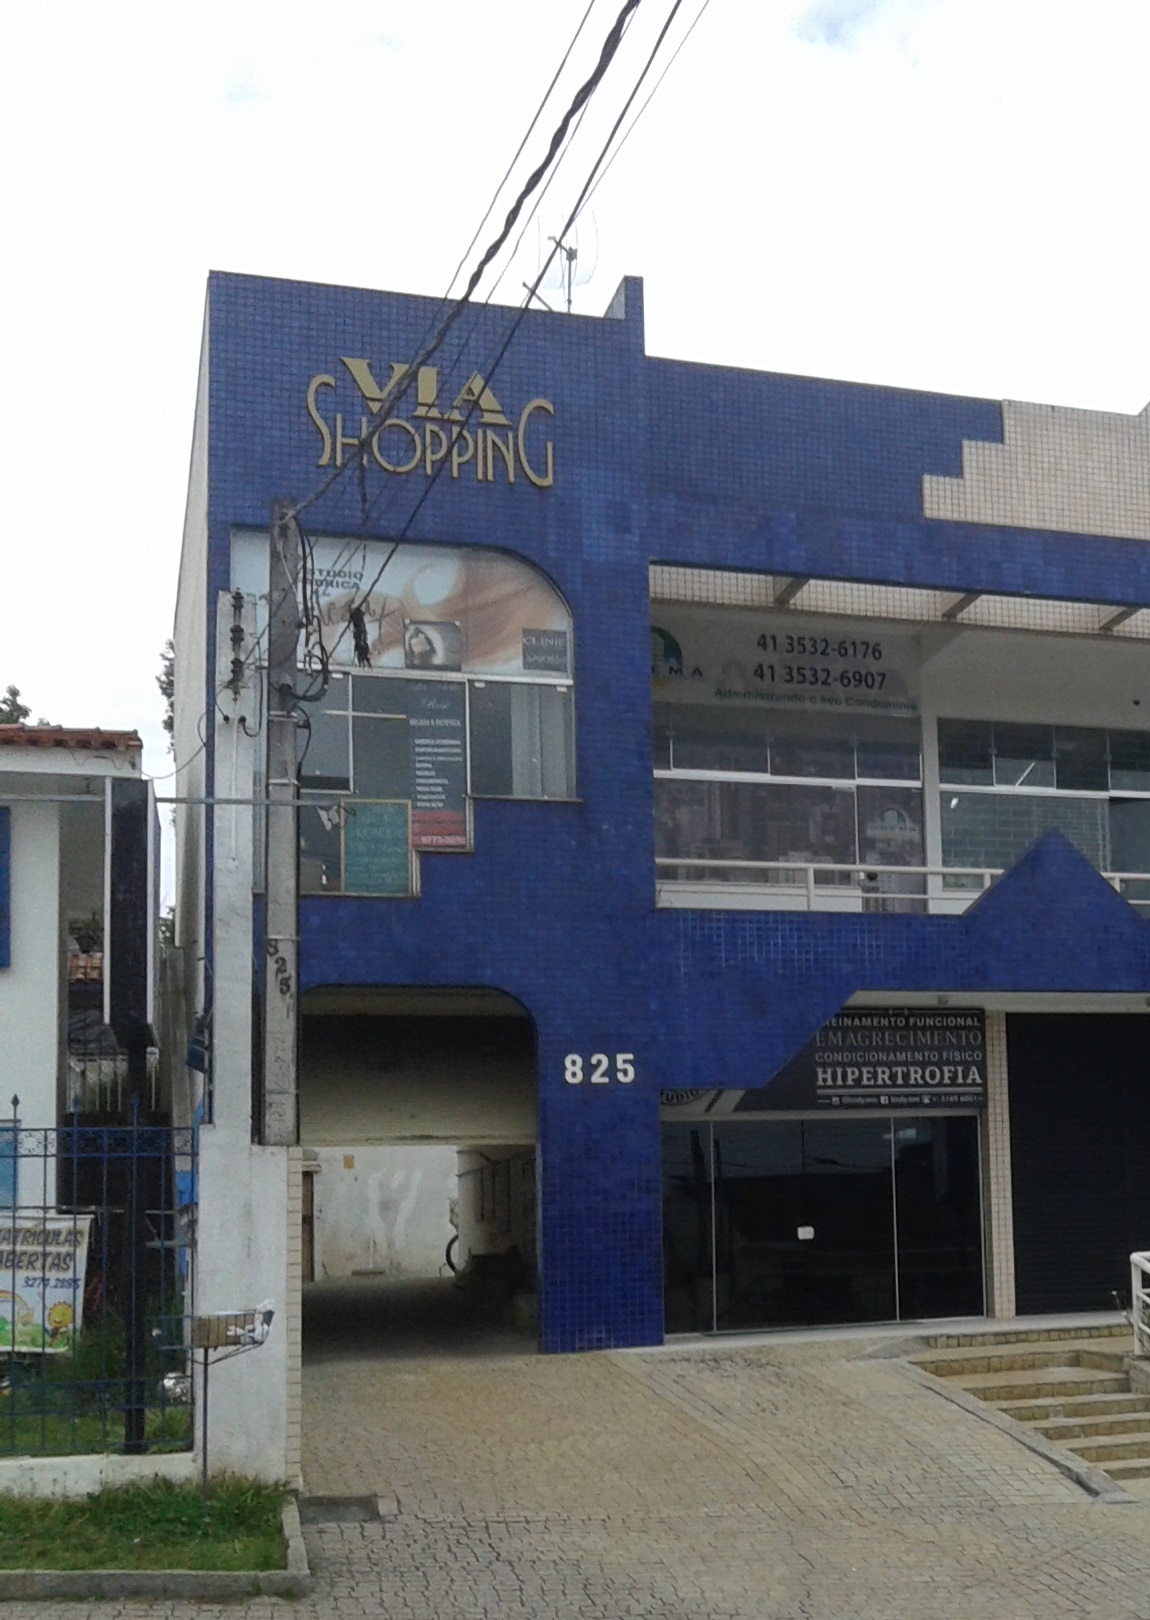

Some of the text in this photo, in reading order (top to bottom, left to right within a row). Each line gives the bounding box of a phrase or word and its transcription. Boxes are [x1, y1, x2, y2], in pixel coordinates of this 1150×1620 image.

[340, 357, 512, 426] VIA
[306, 374, 554, 488] SHOPPING
[757, 633, 882, 660] 41 3532-6176
[753, 663, 887, 690] 41 3532-6907
[825, 1016, 981, 1028] EINAMENTO FUNCIONAL
[815, 1028, 982, 1047] EMAGRECIMENTO
[564, 1053, 635, 1084] 825
[815, 1050, 939, 1063] CONDICIONAMENTO
[815, 1065, 983, 1087] HIPERTROFIA
